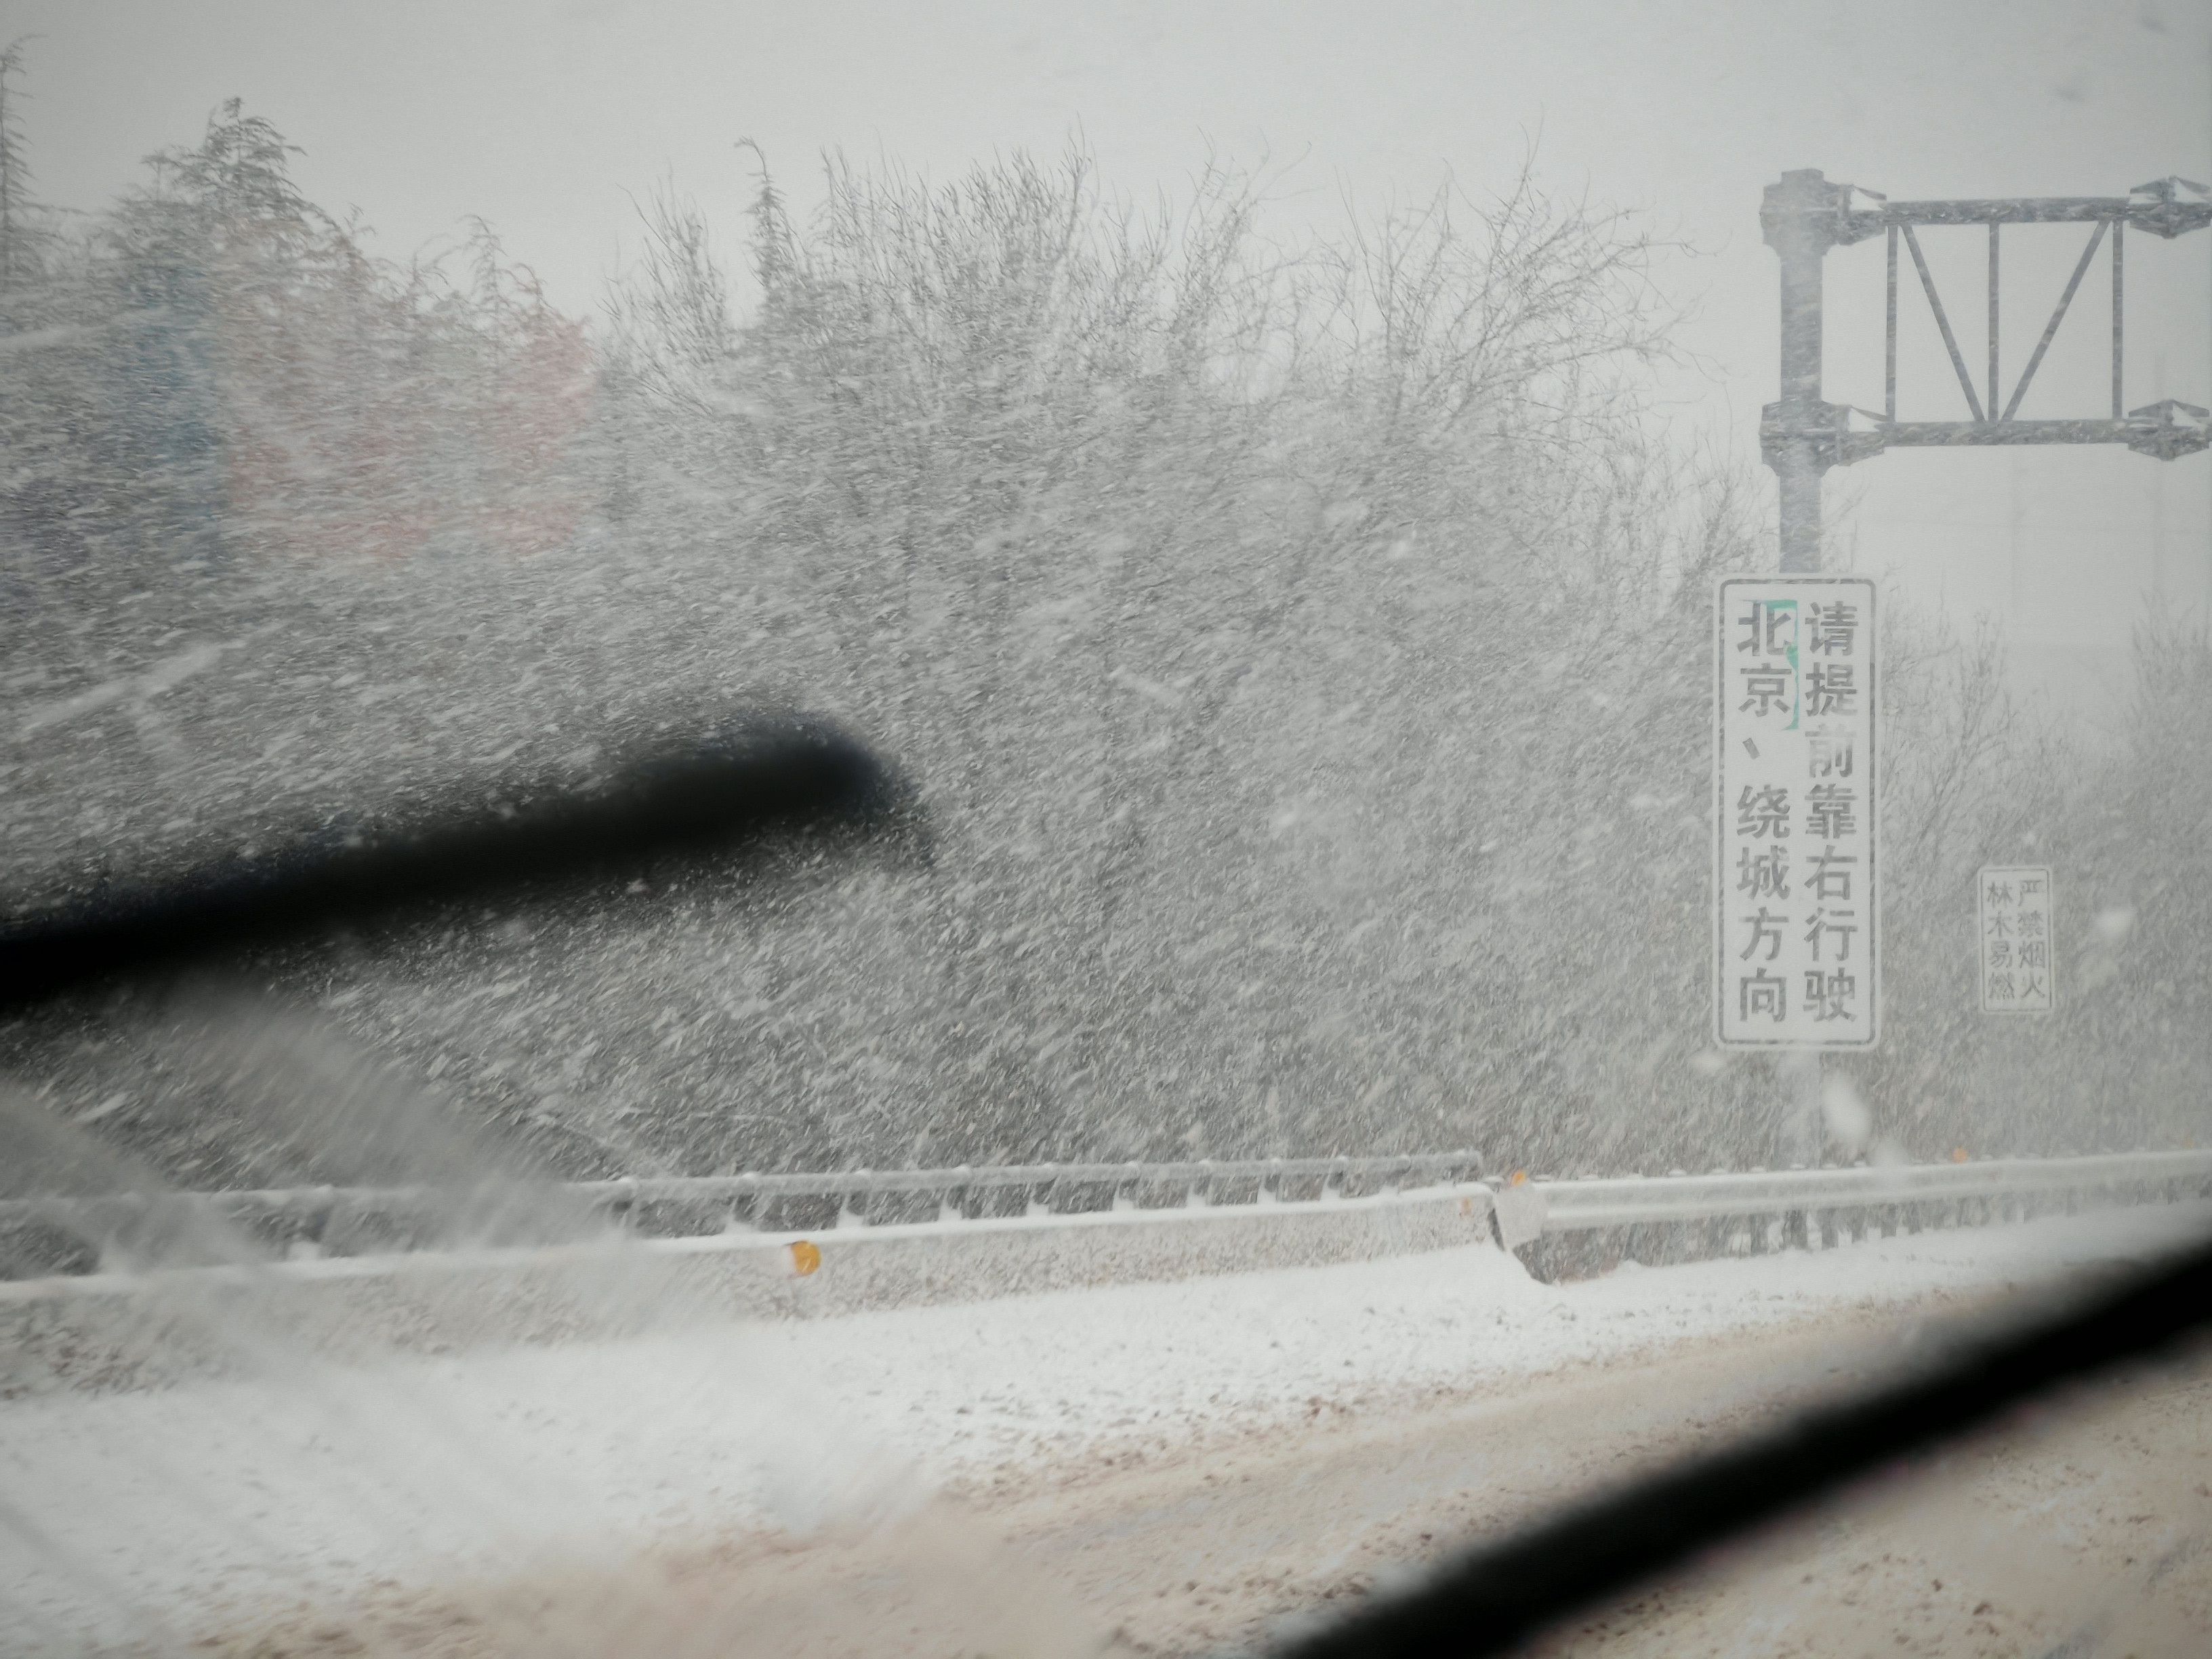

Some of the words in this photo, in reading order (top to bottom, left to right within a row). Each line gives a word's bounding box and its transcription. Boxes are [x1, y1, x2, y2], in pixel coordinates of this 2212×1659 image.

[1737, 600, 1791, 1023] 北京、绕城方向
[1803, 600, 1858, 1023] 请提前靠右行驶
[1987, 881, 2015, 1001] 林木易燃
[2018, 880, 2046, 1000] 严禁烟火
